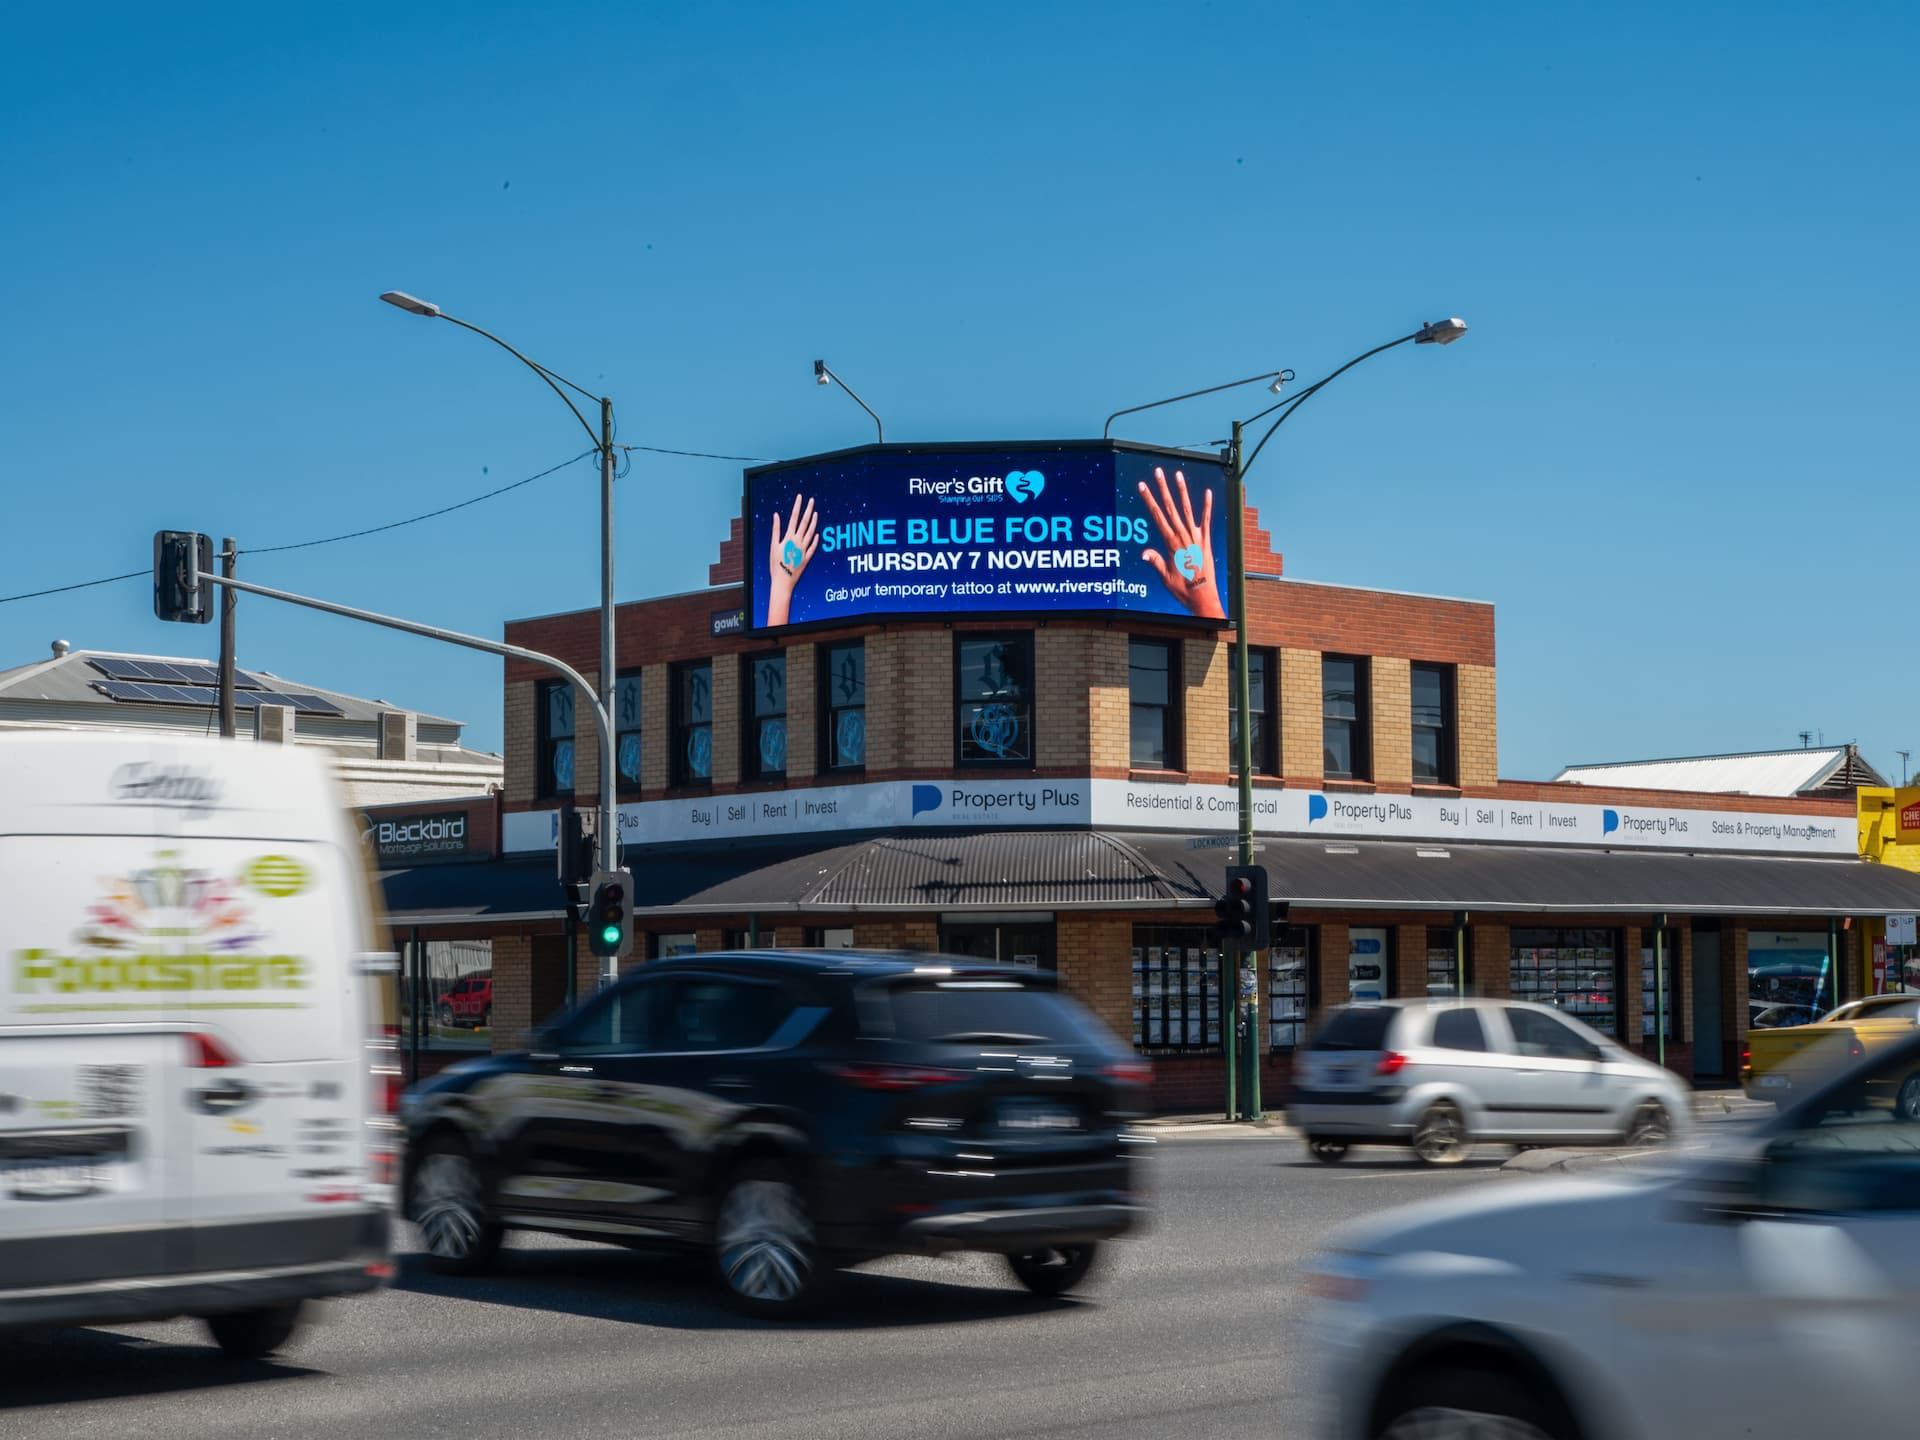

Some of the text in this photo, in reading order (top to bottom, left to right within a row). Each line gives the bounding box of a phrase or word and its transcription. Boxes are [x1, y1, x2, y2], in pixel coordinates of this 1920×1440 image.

[909, 477, 1003, 494] River's Gift
[938, 494, 971, 505] Stamping
[822, 515, 1149, 552] SHINE BLUE FOR SIDS
[848, 549, 1121, 574] THURSDAY 7 NOVEMBER
[825, 578, 1147, 602] Grab your temporary tattoo at www.riversgift.org
[714, 615, 739, 633] gawk
[952, 788, 1079, 811] Property Plus
[1127, 792, 1277, 814] Residential & Commrcial
[618, 813, 639, 828] Plus
[692, 800, 837, 826] Buy Sell Rent Invest
[1334, 801, 1412, 823] Property Plus
[1440, 808, 1577, 828] Buy Sell Rent Invest
[379, 817, 464, 843] Blackbird
[1623, 815, 1688, 832] Property Plus
[1712, 821, 1836, 841] Sales & Property Management
[423, 840, 464, 852] Solutions
